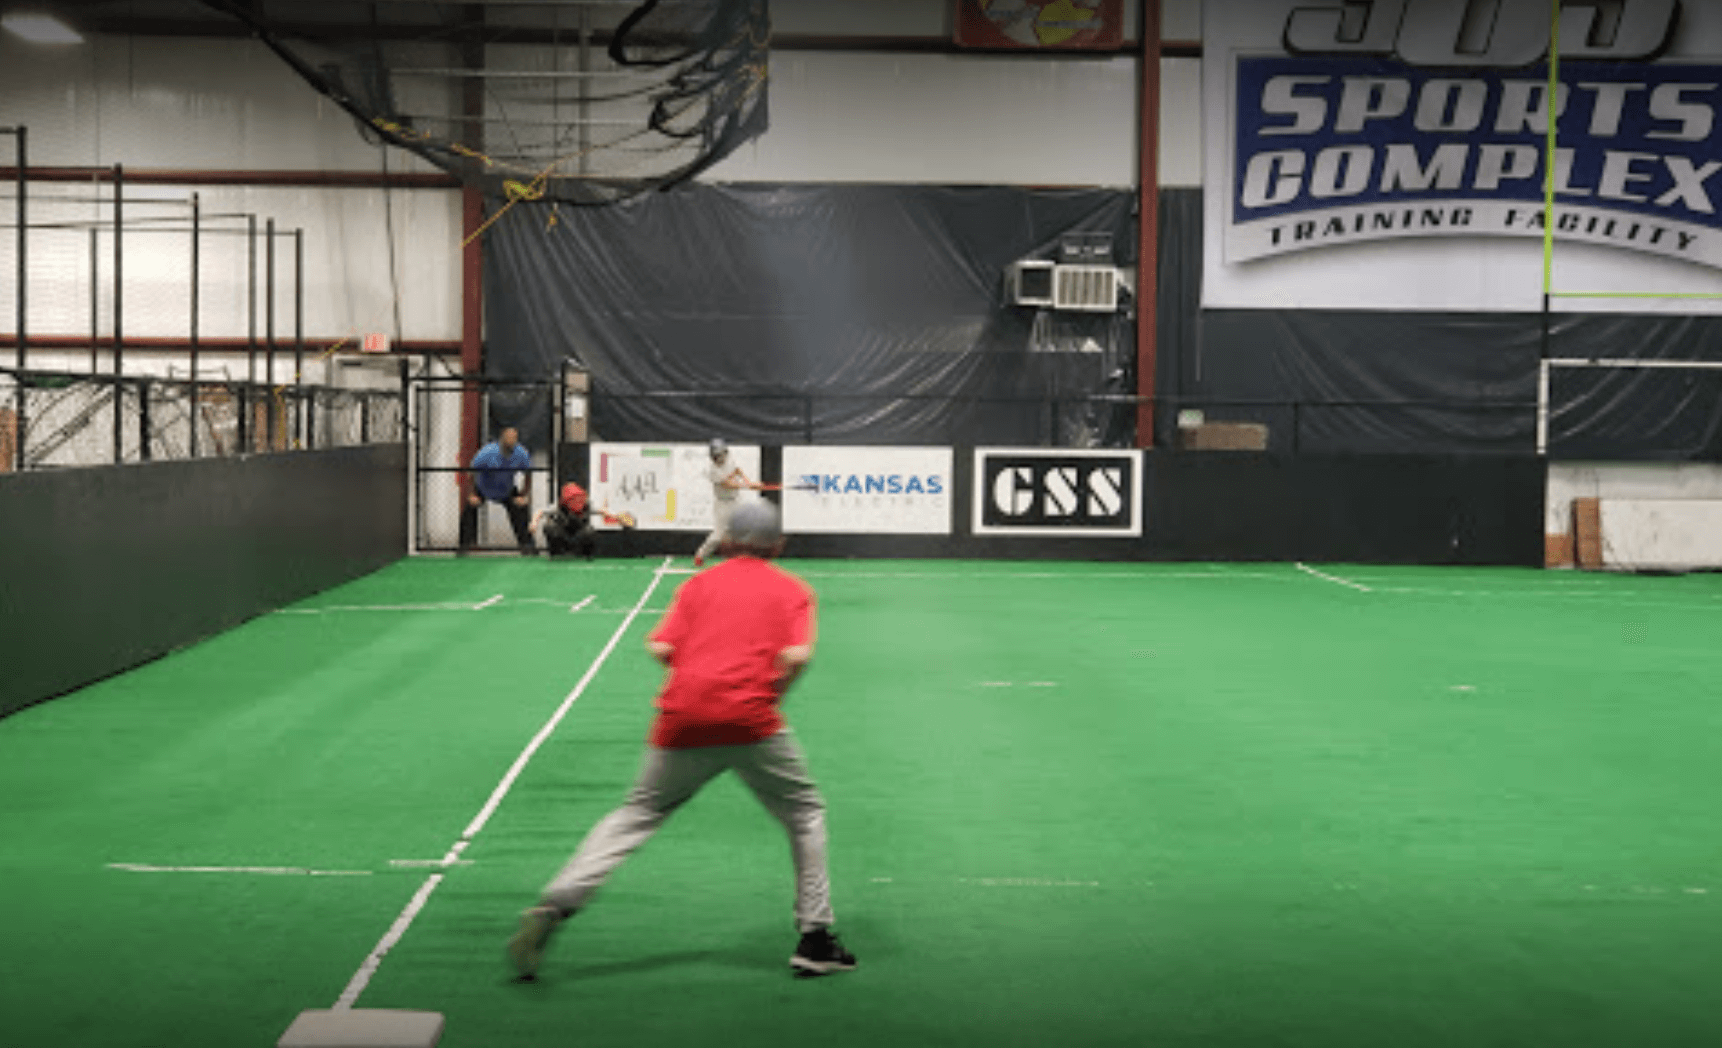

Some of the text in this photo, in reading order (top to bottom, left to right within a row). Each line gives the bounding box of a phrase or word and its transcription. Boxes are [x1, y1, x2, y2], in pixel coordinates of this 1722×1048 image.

[1258, 75, 1719, 141] SPORTS
[1242, 143, 1722, 214] COMPLEX
[1266, 207, 1698, 251] TRAINING FACILITY
[822, 474, 943, 494] KANSAS
